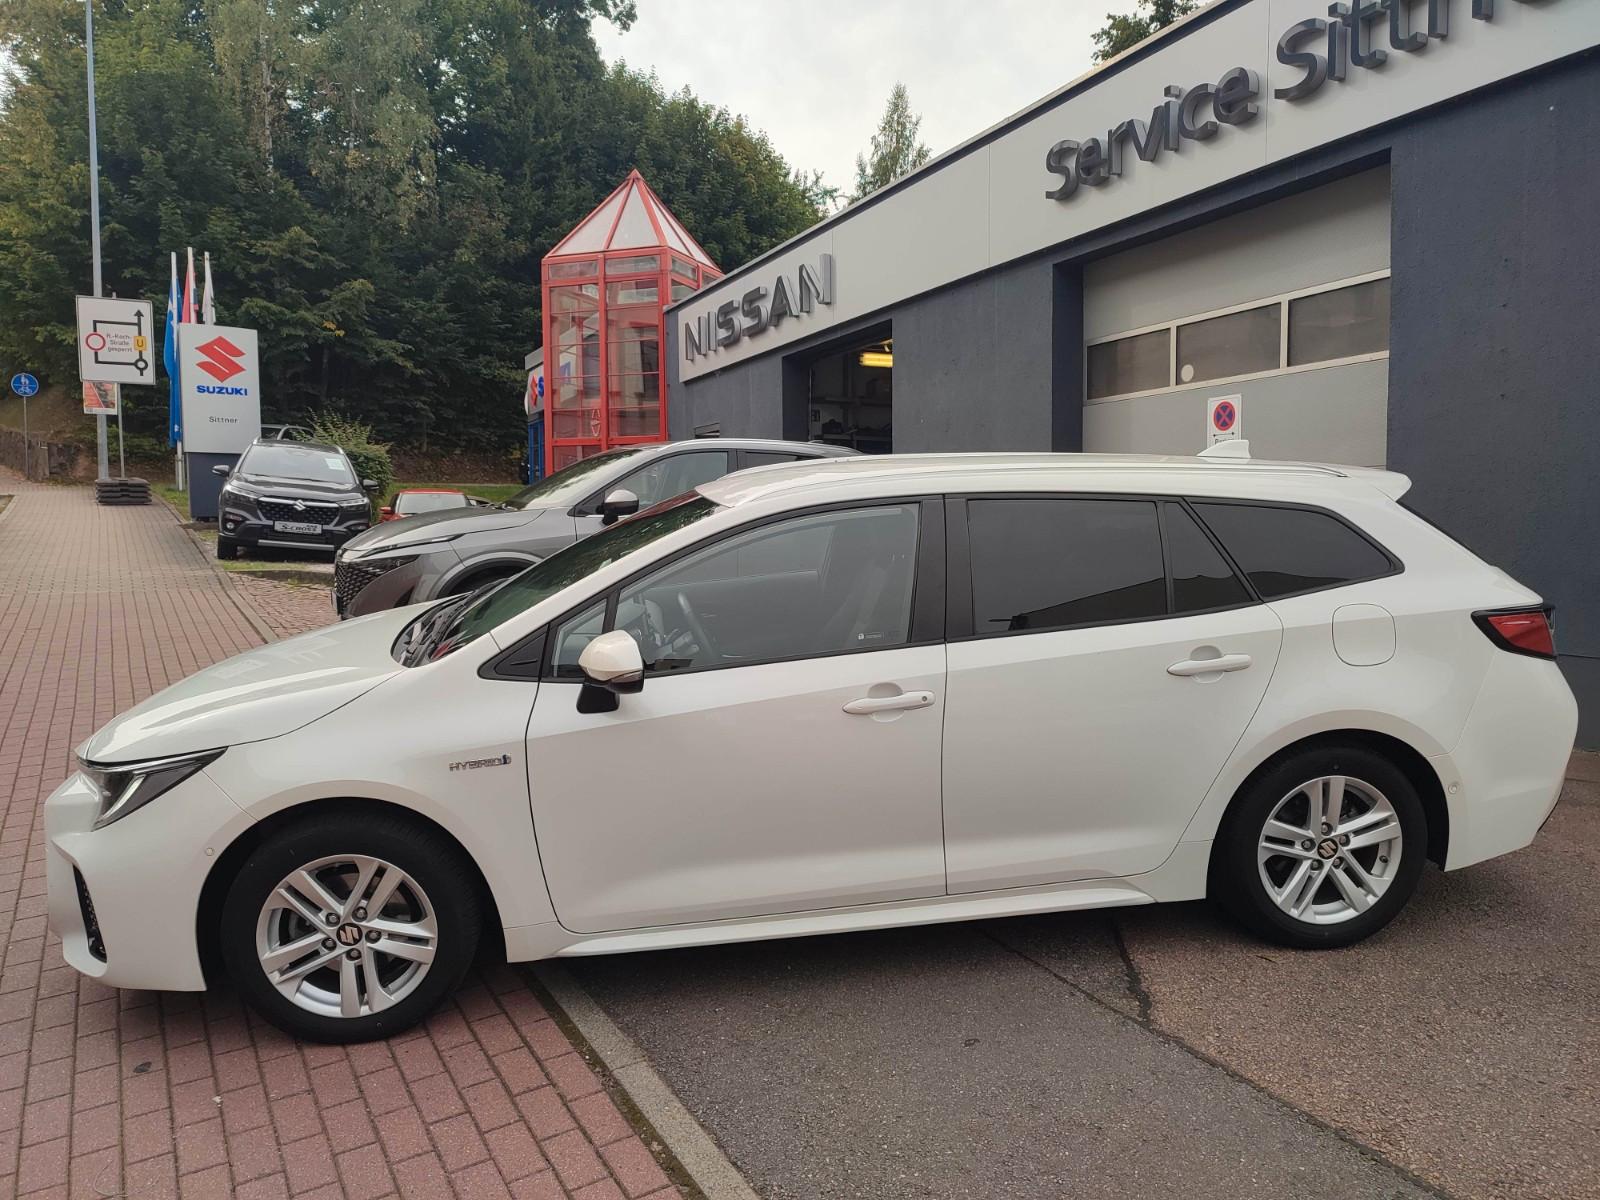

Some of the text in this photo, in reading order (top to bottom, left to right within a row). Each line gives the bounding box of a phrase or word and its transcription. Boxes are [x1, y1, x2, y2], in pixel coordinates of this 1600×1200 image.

[1046, 67, 1259, 200] Service
[685, 254, 832, 361] NISSAN
[136, 339, 144, 347] U
[196, 385, 248, 396] SUZUKI
[208, 416, 238, 424] Sittner
[449, 757, 502, 771] HYBRID
